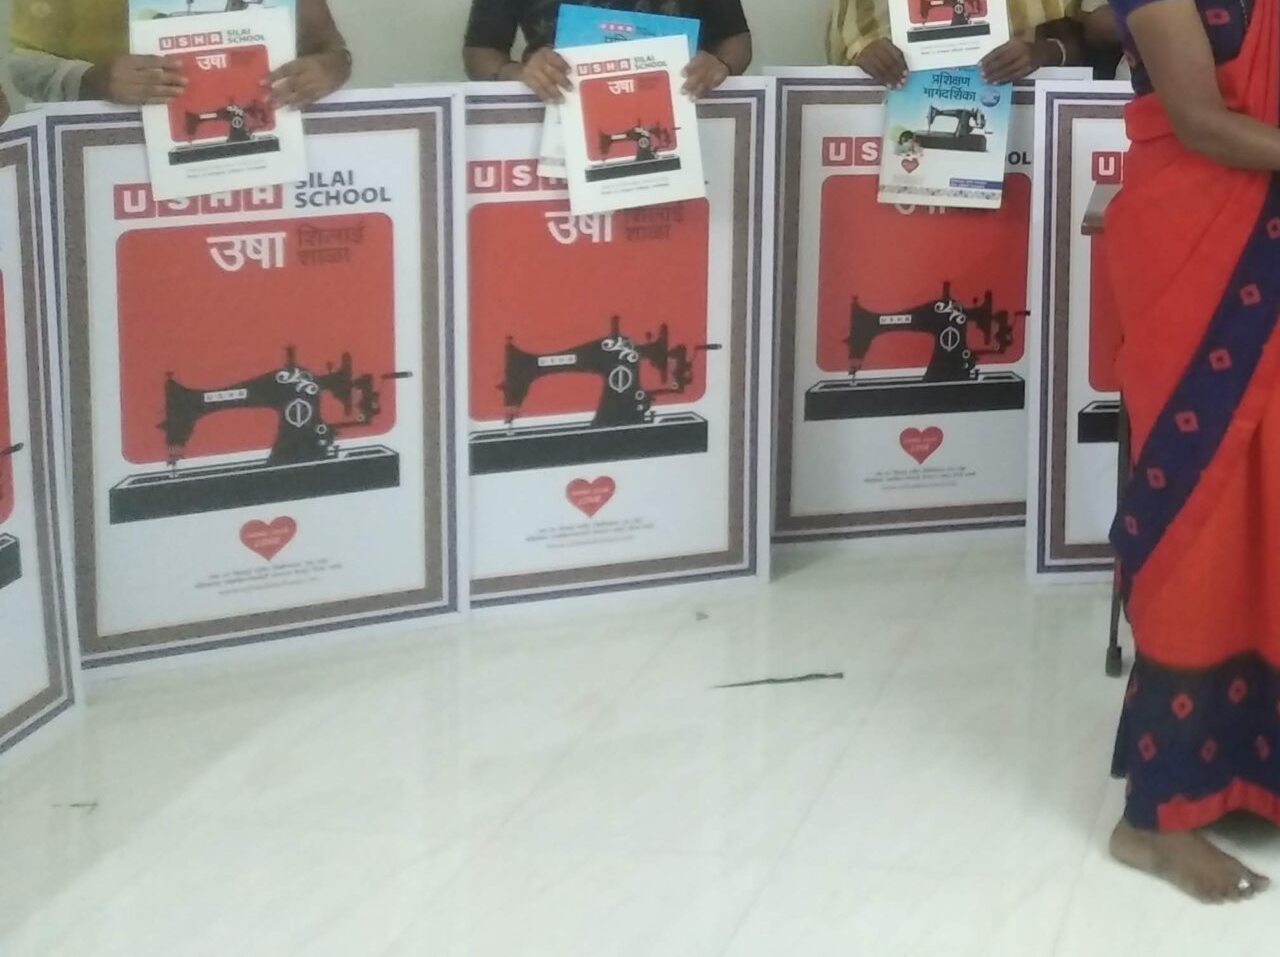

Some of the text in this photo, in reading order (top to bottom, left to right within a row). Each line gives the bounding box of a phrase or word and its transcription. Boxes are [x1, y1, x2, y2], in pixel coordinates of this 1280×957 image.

[161, 32, 222, 50] USHA
[196, 54, 227, 70] उषा
[579, 59, 630, 76] USHA
[607, 78, 635, 95] उषा
[829, 141, 879, 162] US
[294, 187, 392, 209] SCHOOL
[206, 232, 287, 272] उषा
